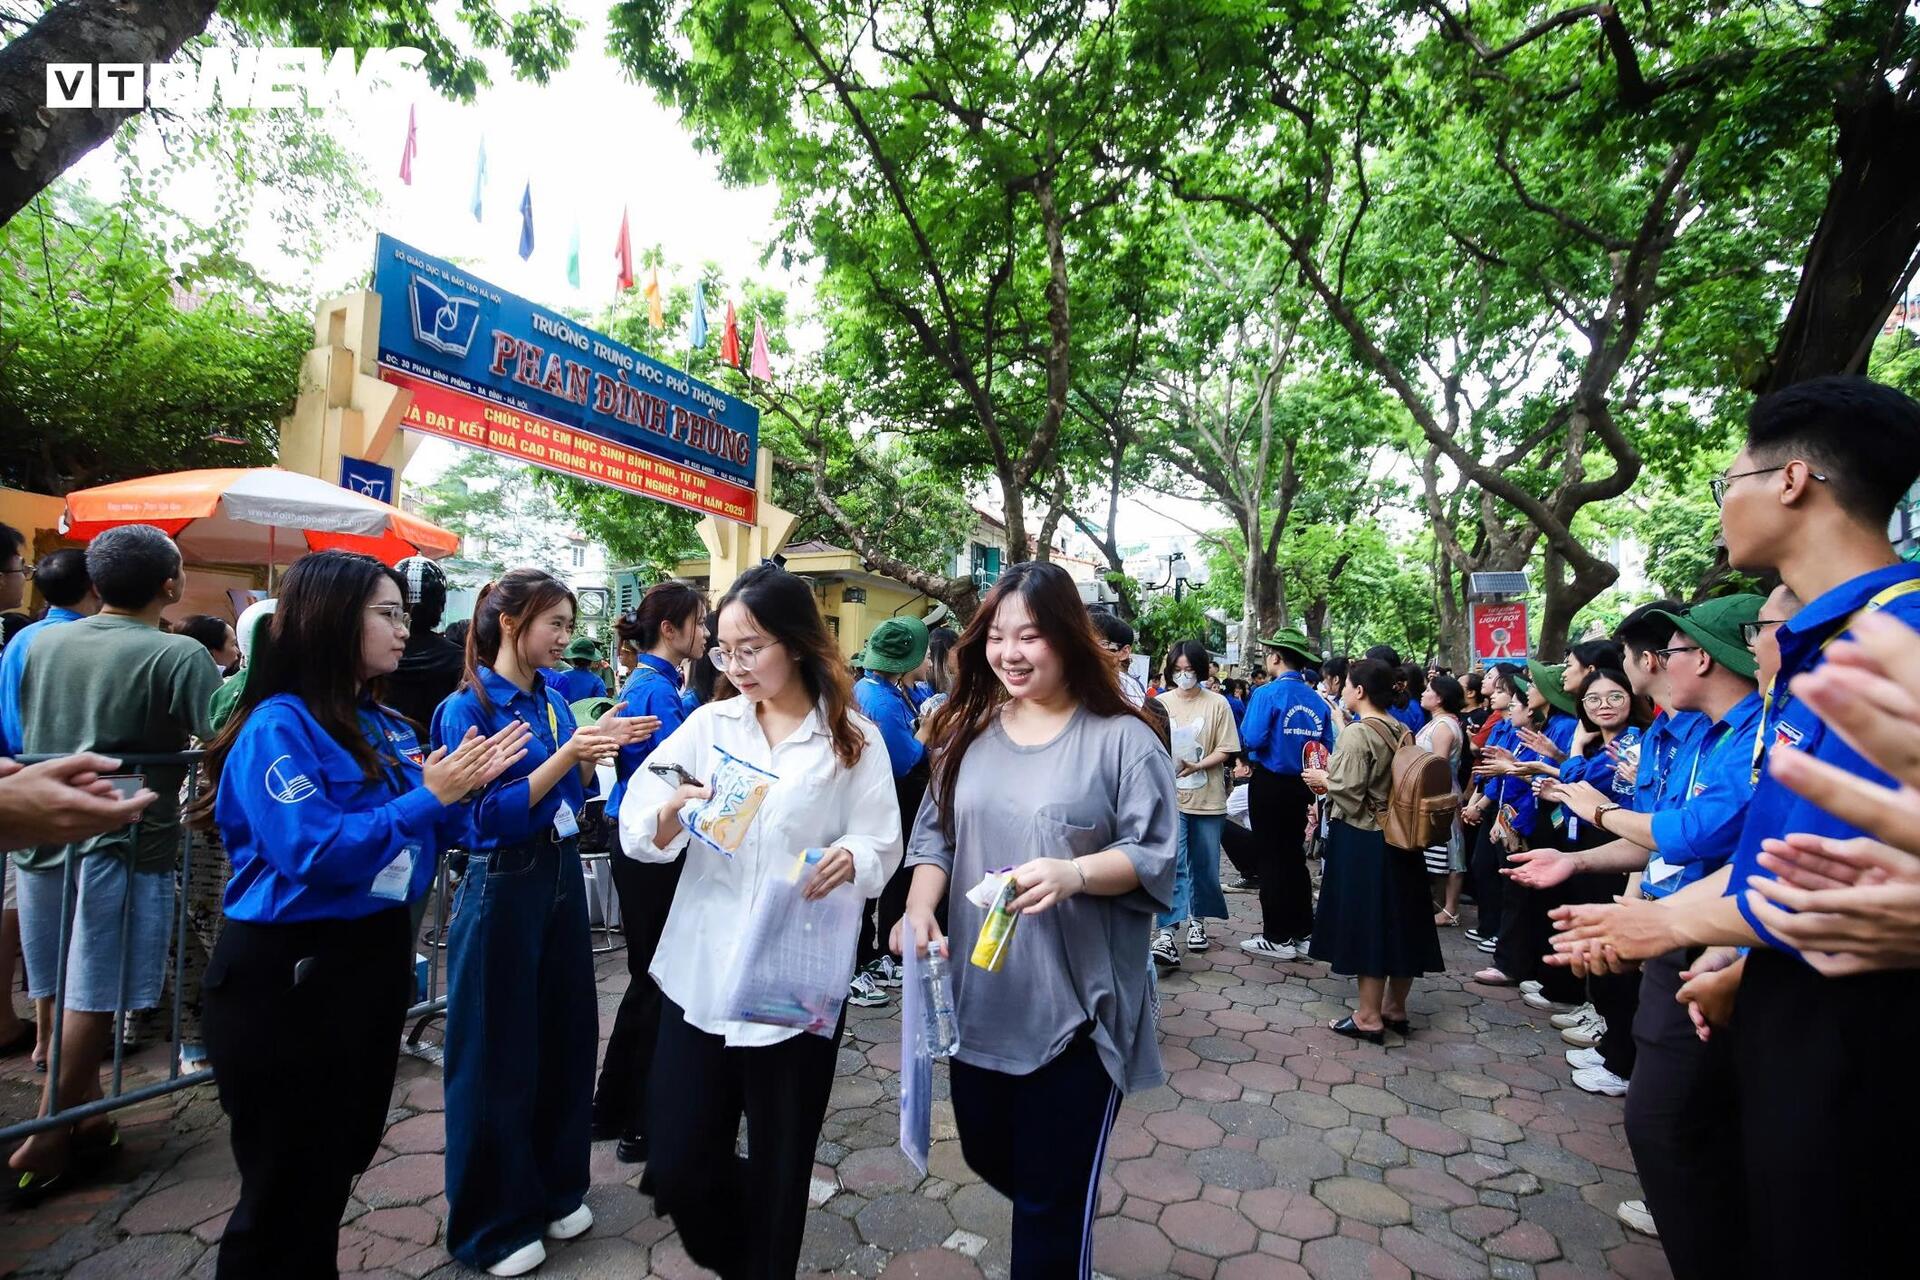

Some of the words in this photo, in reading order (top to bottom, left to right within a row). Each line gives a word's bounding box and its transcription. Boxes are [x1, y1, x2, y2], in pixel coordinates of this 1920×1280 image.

[412, 363, 431, 377] PHAN
[433, 367, 449, 382] ĐÌNH
[450, 376, 472, 391] PHÙNG
[489, 329, 592, 406] PHAN
[592, 368, 669, 436] ĐÌNH
[669, 409, 751, 467] PHÙNG
[532, 312, 590, 351] TRƯỜNG
[593, 341, 633, 371] TRUNG
[635, 359, 663, 384] HỌC
[666, 374, 689, 395] PHỔ
[692, 386, 726, 412] THÔNG
[425, 410, 455, 431] ĐẠT
[458, 420, 486, 440] KẾT
[488, 430, 517, 449] QUẢ
[519, 439, 546, 457] CAO
[549, 447, 587, 470] TRONG
[589, 459, 603, 475] KỲ
[606, 465, 623, 479] THI
[626, 470, 643, 486] TỐT
[645, 478, 680, 498] NGHIỆP
[681, 488, 703, 503] THPT
[703, 495, 724, 511] NĂM
[724, 502, 746, 518] 2025!
[484, 407, 521, 430] CHÚC
[523, 419, 550, 438] CÁC
[552, 433, 571, 447] EM
[573, 436, 597, 454] HỌC
[600, 446, 625, 463] SINH
[628, 452, 651, 470] BÌNH
[679, 471, 691, 487] TỰ
[692, 476, 707, 490] TIN
[1479, 616, 1502, 624] LIGHT
[1502, 614, 1521, 622] BOX
